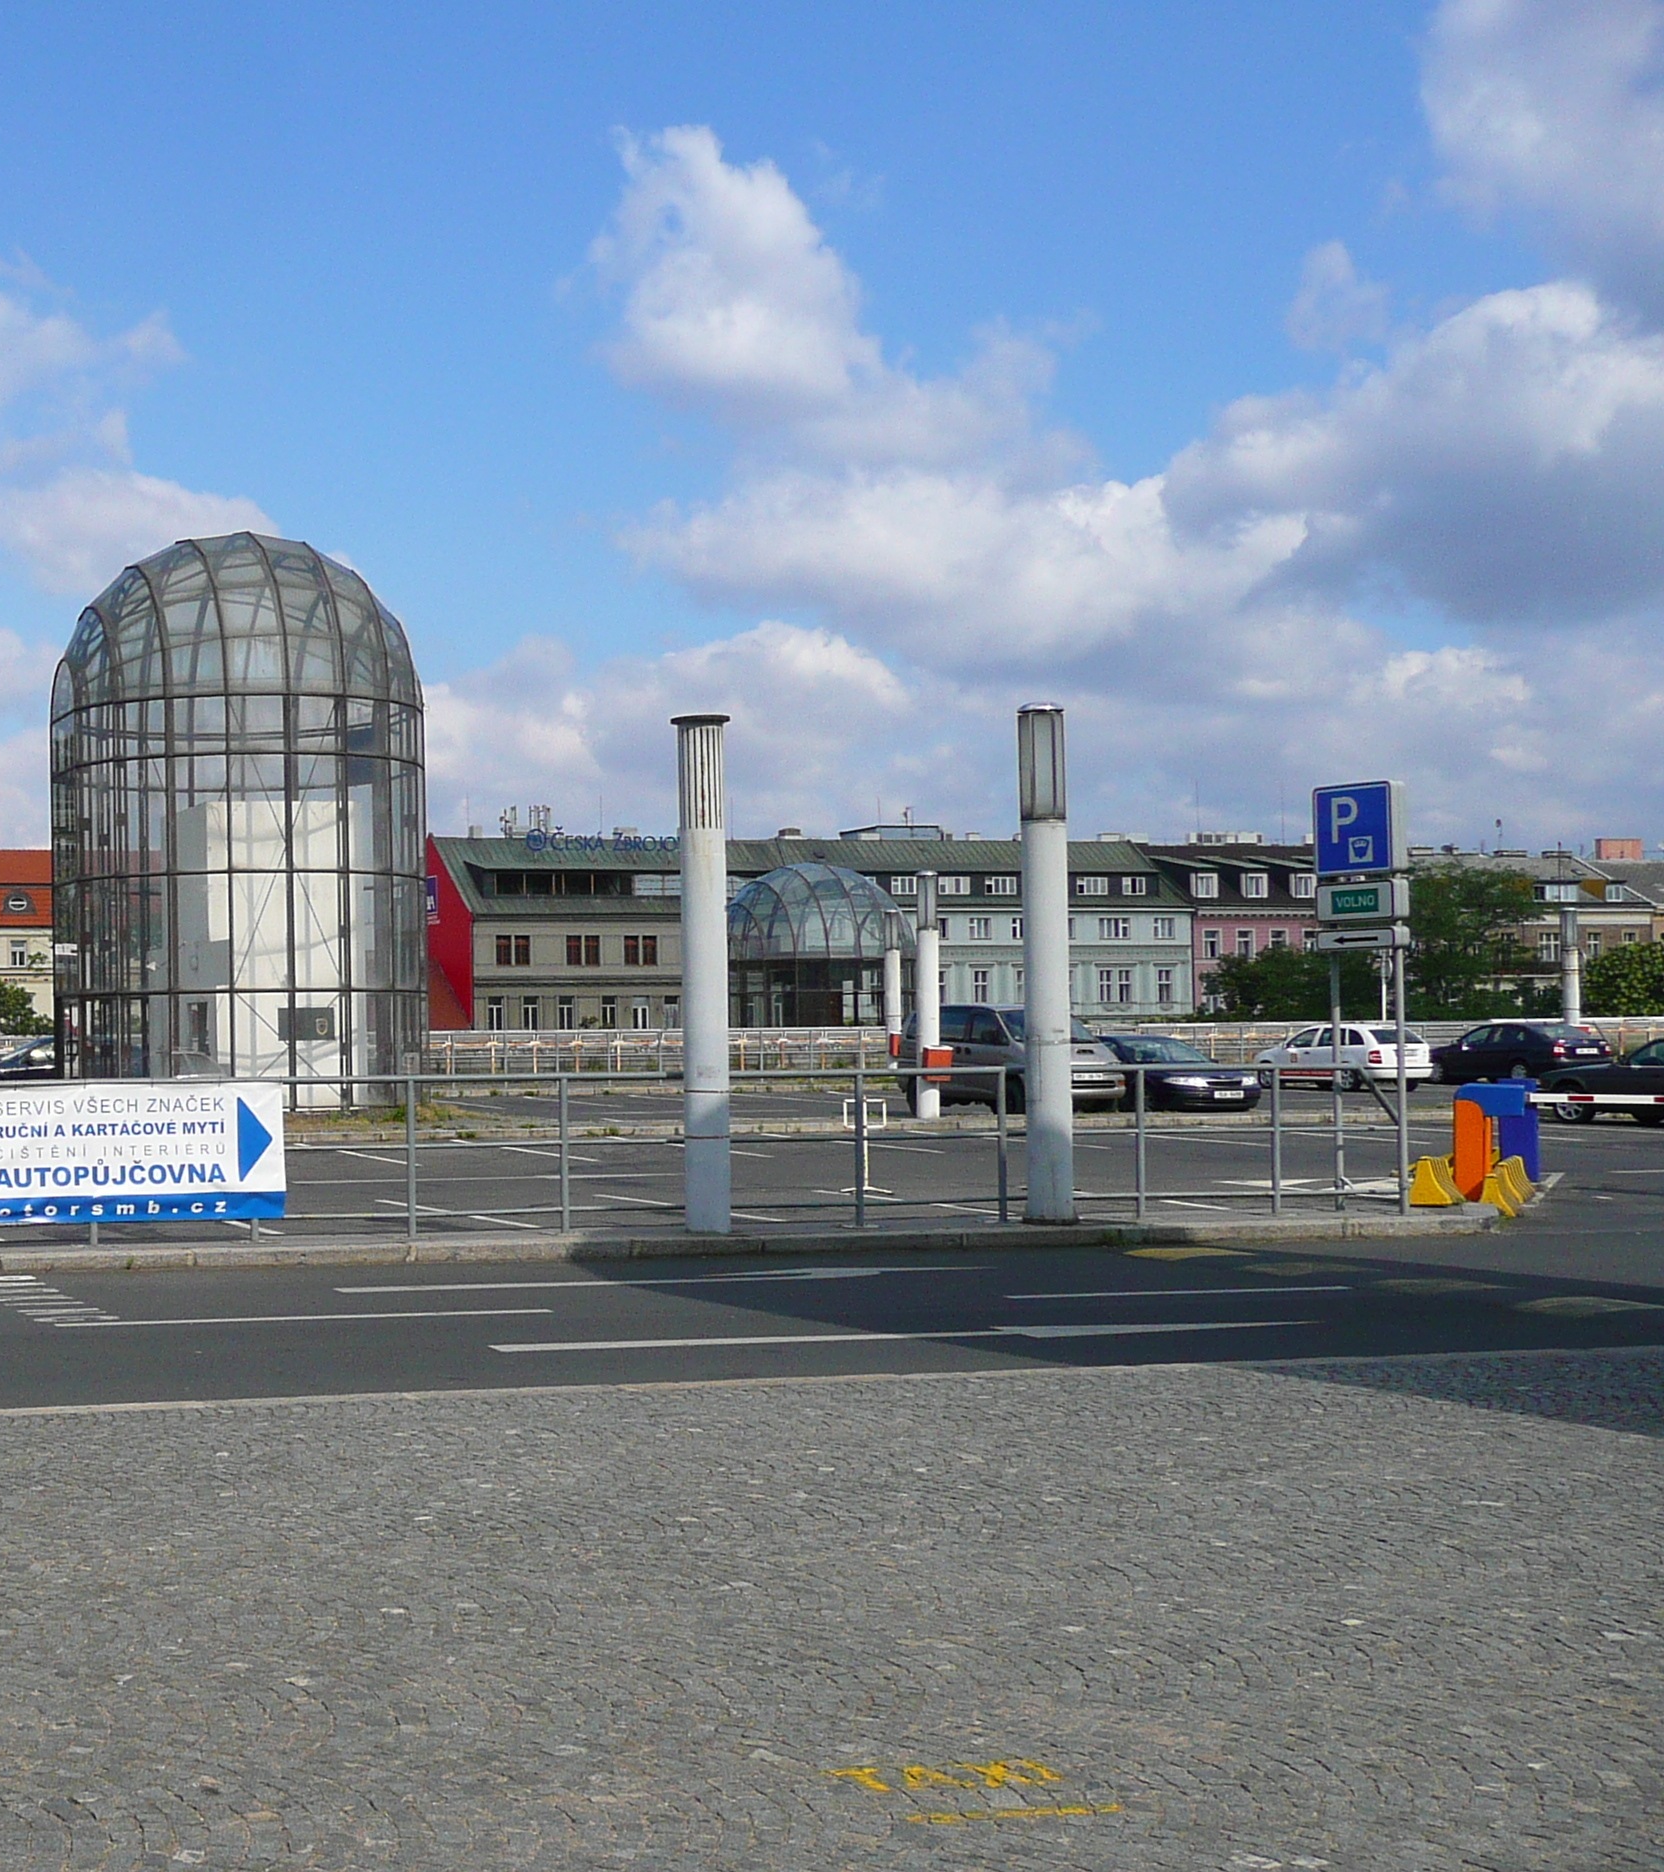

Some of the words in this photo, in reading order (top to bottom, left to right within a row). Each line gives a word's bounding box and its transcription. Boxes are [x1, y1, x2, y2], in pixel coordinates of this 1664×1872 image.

[1331, 796, 1358, 844] P
[550, 826, 606, 851] ČESKÁ
[612, 832, 681, 851] ZBROJO
[1336, 895, 1375, 908] VOLNO
[73, 1095, 139, 1114] VŠECH
[146, 1094, 225, 1113] ZNAČEK
[54, 1123, 66, 1137] A
[71, 1119, 177, 1137] KARTÁČOVÉ
[182, 1119, 225, 1135] MYTÍ
[102, 1143, 225, 1157] INTERIÉRŮ
